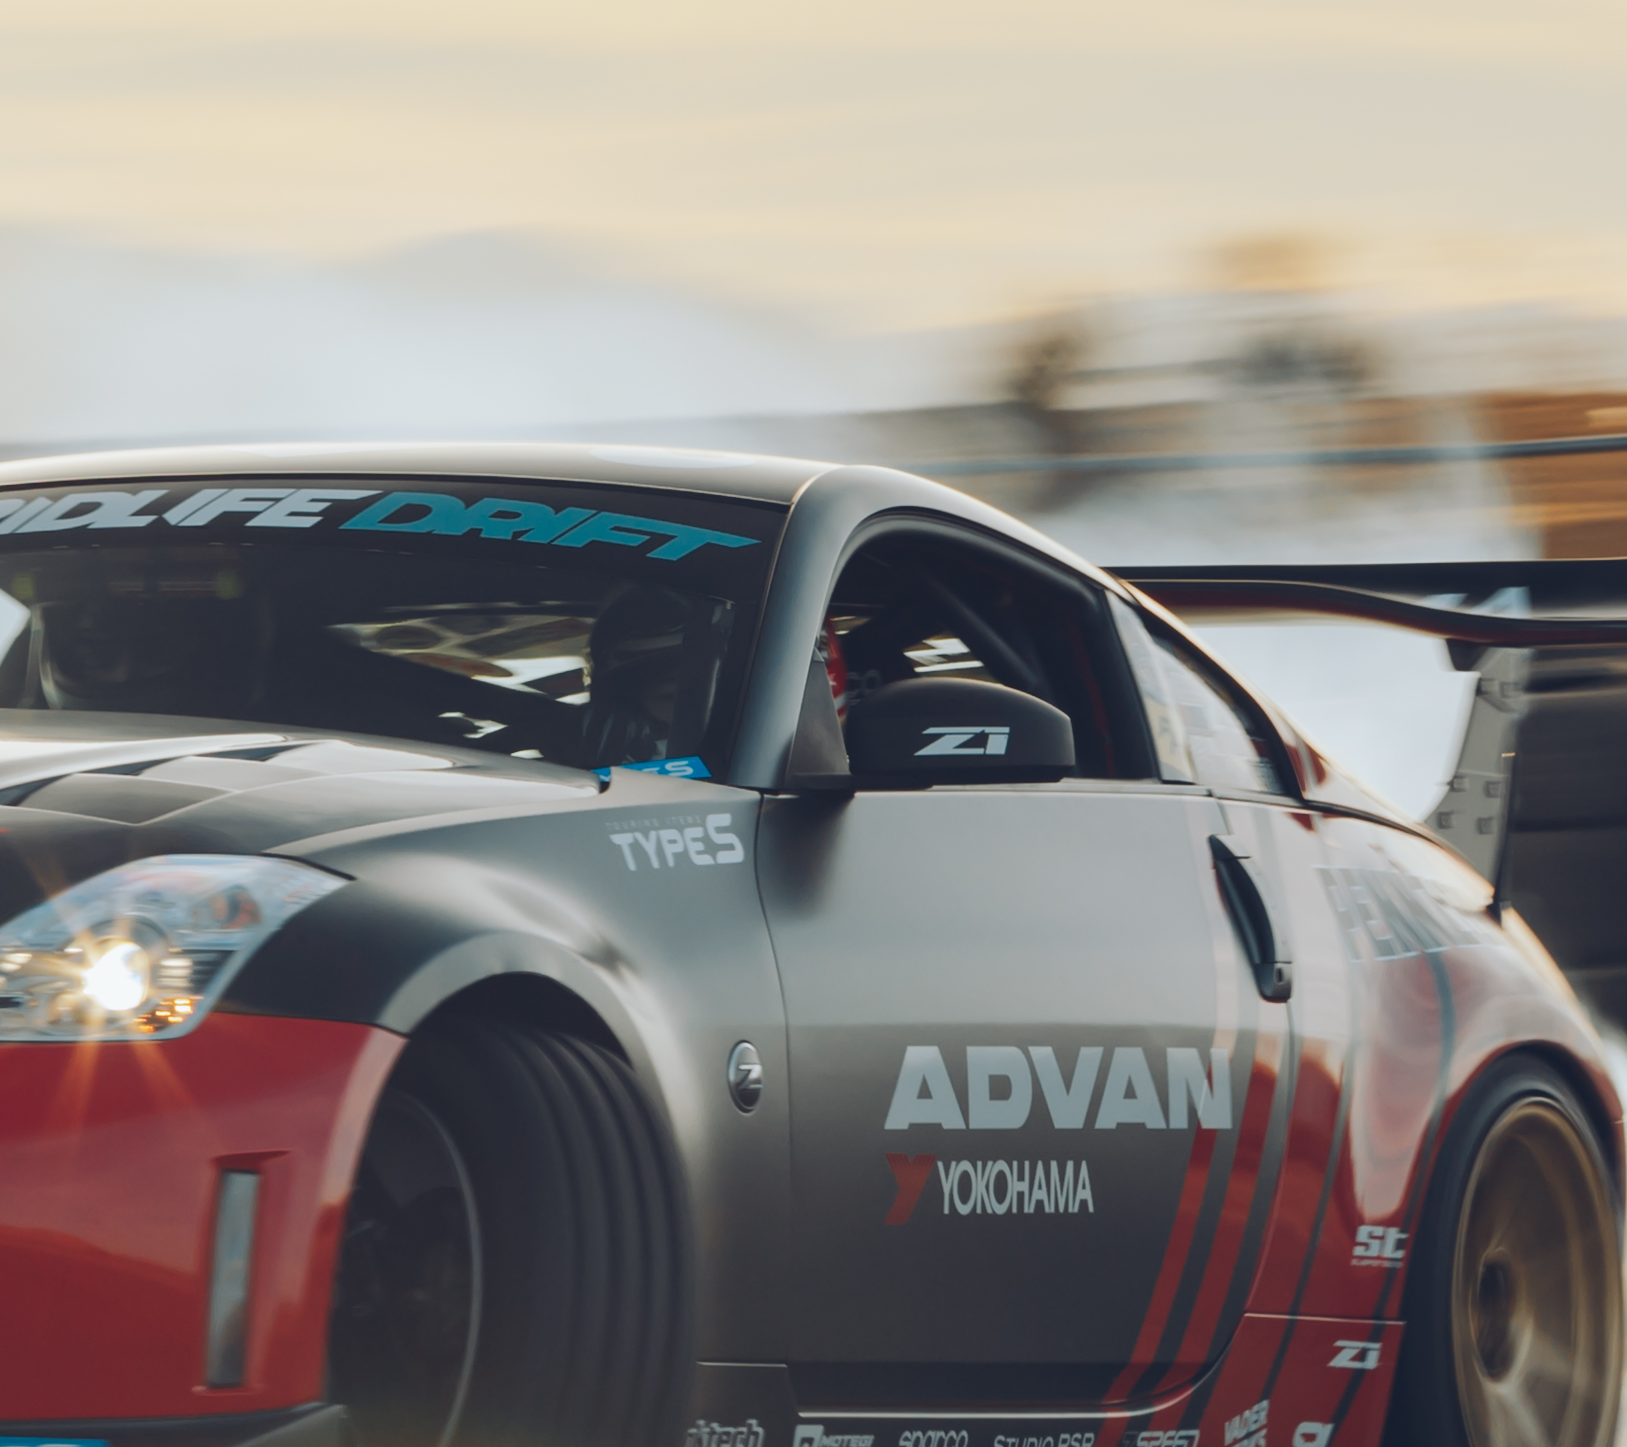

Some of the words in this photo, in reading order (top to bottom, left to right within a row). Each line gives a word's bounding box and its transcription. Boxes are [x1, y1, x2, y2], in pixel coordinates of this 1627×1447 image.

[338, 491, 761, 560] DRIFT
[884, 1045, 1233, 1129] ADVAN
[937, 1159, 1094, 1215] YOKOHAMA
[819, 1434, 875, 1447] MOTEGI
